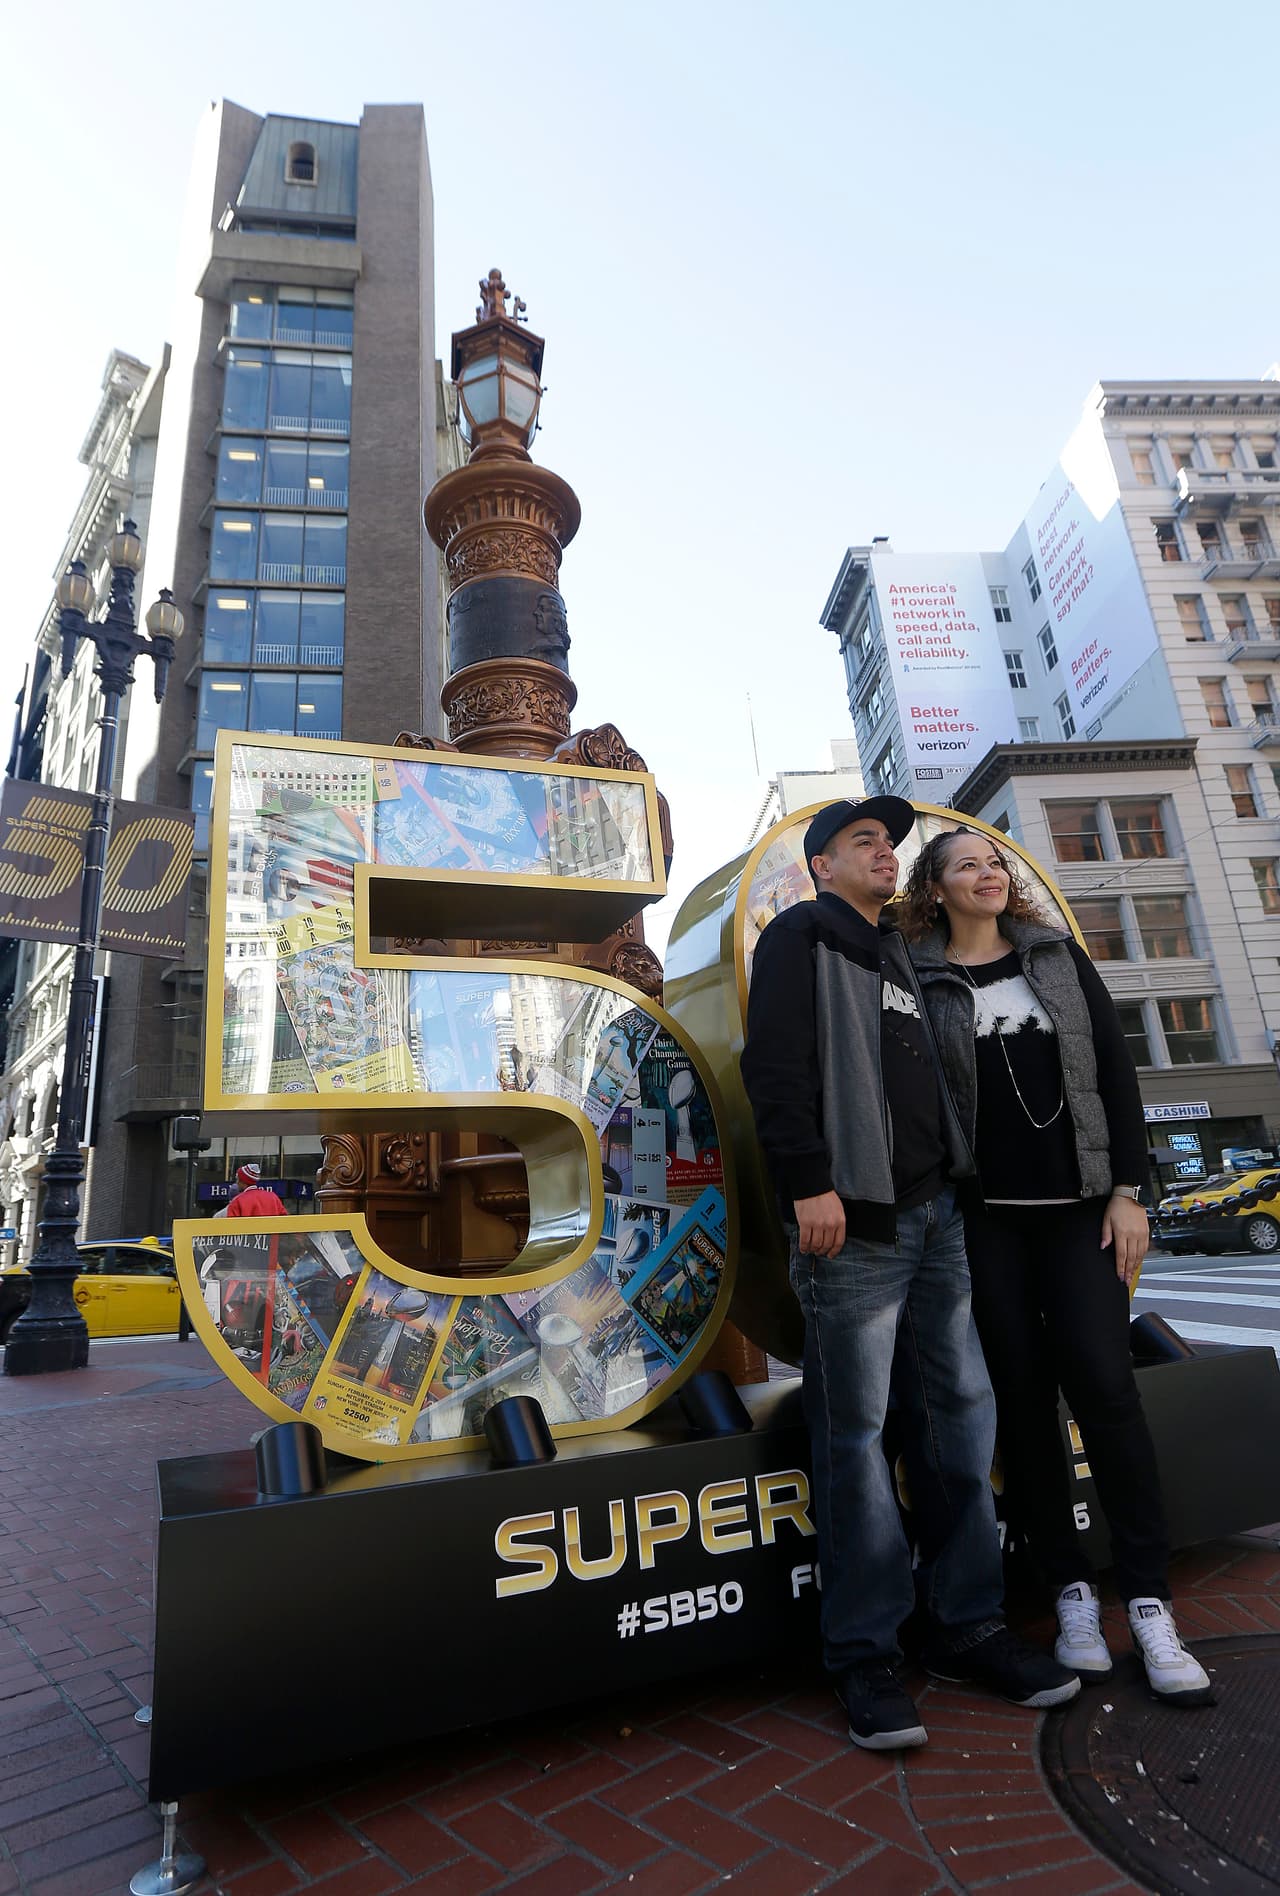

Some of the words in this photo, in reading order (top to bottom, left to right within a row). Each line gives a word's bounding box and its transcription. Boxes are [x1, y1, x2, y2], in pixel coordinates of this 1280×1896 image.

[1040, 526, 1058, 557] best
[1044, 520, 1080, 572] network.
[1049, 564, 1065, 591] Can
[1065, 536, 1085, 569] your
[1052, 556, 1088, 607] network
[889, 584, 957, 593] America's
[1057, 599, 1072, 622] say
[1071, 564, 1094, 601] that?
[891, 597, 906, 606] #1
[909, 596, 955, 606] overall
[893, 609, 950, 619] network
[953, 608, 965, 618] in
[896, 622, 942, 633] speed,
[945, 621, 980, 632] data,
[898, 635, 922, 645] call
[926, 634, 951, 644] and
[900, 648, 969, 659] reliability.
[1071, 638, 1098, 676] Better
[1075, 648, 1112, 691] matters.
[1080, 675, 1108, 709] verizon
[911, 707, 959, 718] Better
[914, 722, 979, 733] matters.
[917, 740, 966, 750] verizon
[6, 817, 48, 835] SUPER
[50, 826, 83, 841] BOWL
[336, 908, 342, 919] 5
[303, 917, 313, 928] 10
[337, 922, 351, 934] 205
[456, 991, 490, 1002] SUPER
[653, 1039, 674, 1047] Third
[667, 1060, 690, 1068] Game
[1155, 1106, 1208, 1116] CASHING
[637, 1119, 646, 1127] 4
[637, 1185, 647, 1193] 10
[652, 1210, 660, 1251] SUPER
[219, 1235, 251, 1248] BOWL
[254, 1235, 268, 1251] XL
[693, 1233, 716, 1256] SUPER
[326, 1379, 344, 1390] SUNDAY
[347, 1388, 369, 1400] FEBRUARY
[345, 1393, 363, 1403] METLIFE
[364, 1400, 383, 1410] STADIUM
[343, 1407, 370, 1423] $2500
[373, 1410, 388, 1419] JERSEY
[495, 1469, 817, 1598] SUPER
[617, 1581, 744, 1638] #SB50
